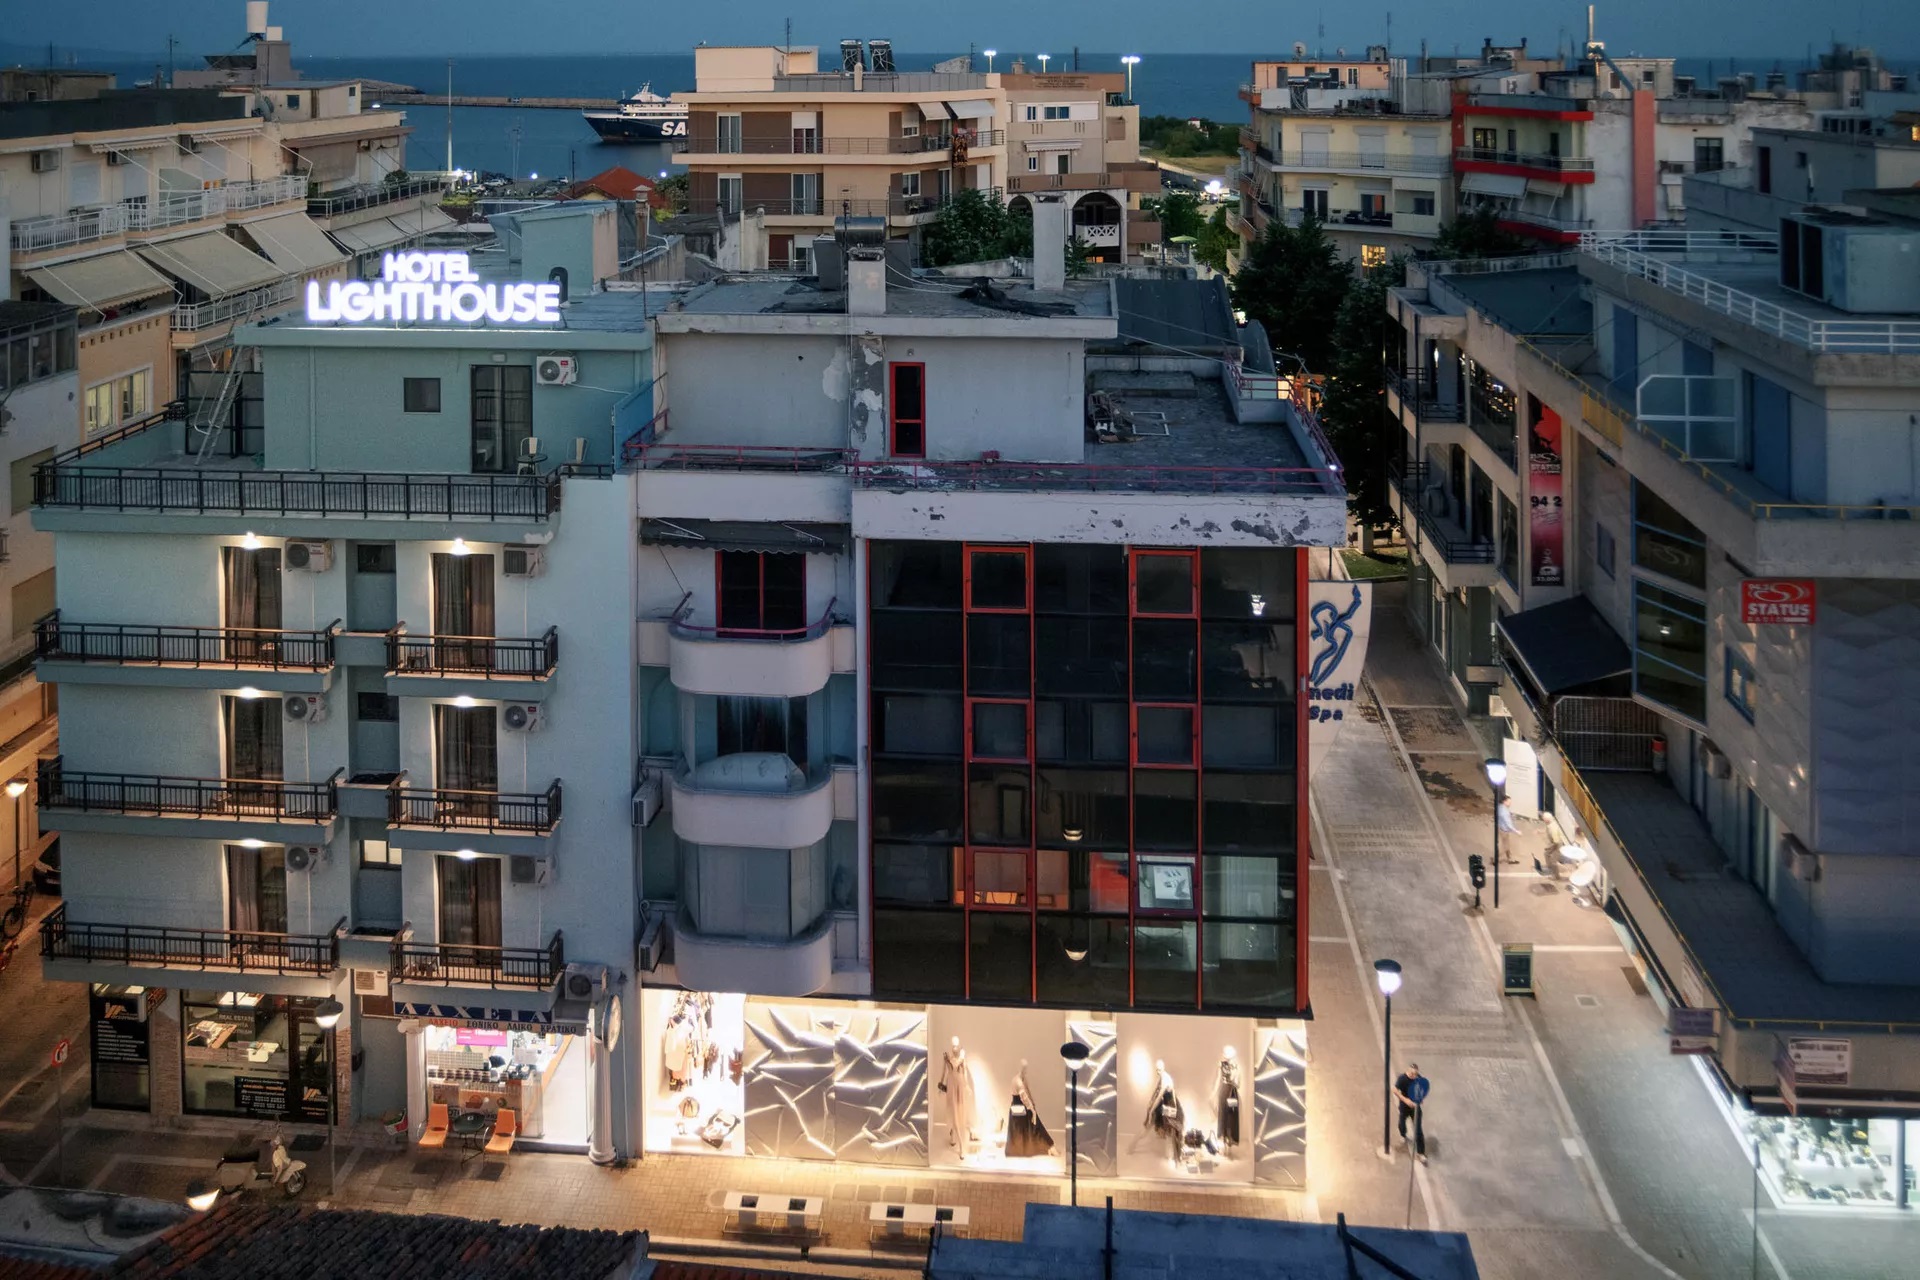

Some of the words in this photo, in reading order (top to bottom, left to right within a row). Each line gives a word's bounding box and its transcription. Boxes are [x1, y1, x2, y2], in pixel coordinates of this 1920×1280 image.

[660, 121, 689, 136] SA
[384, 252, 480, 282] HOTEL
[306, 281, 561, 322] LIGHTHOUSE
[1747, 602, 1810, 616] STATUS
[400, 1001, 548, 1023] ΛΑΧΕΙΑ
[466, 1020, 499, 1030] ΕΘΝΙΚΟ
[540, 1024, 577, 1035] ΚΡΑΤΙΚΟ
